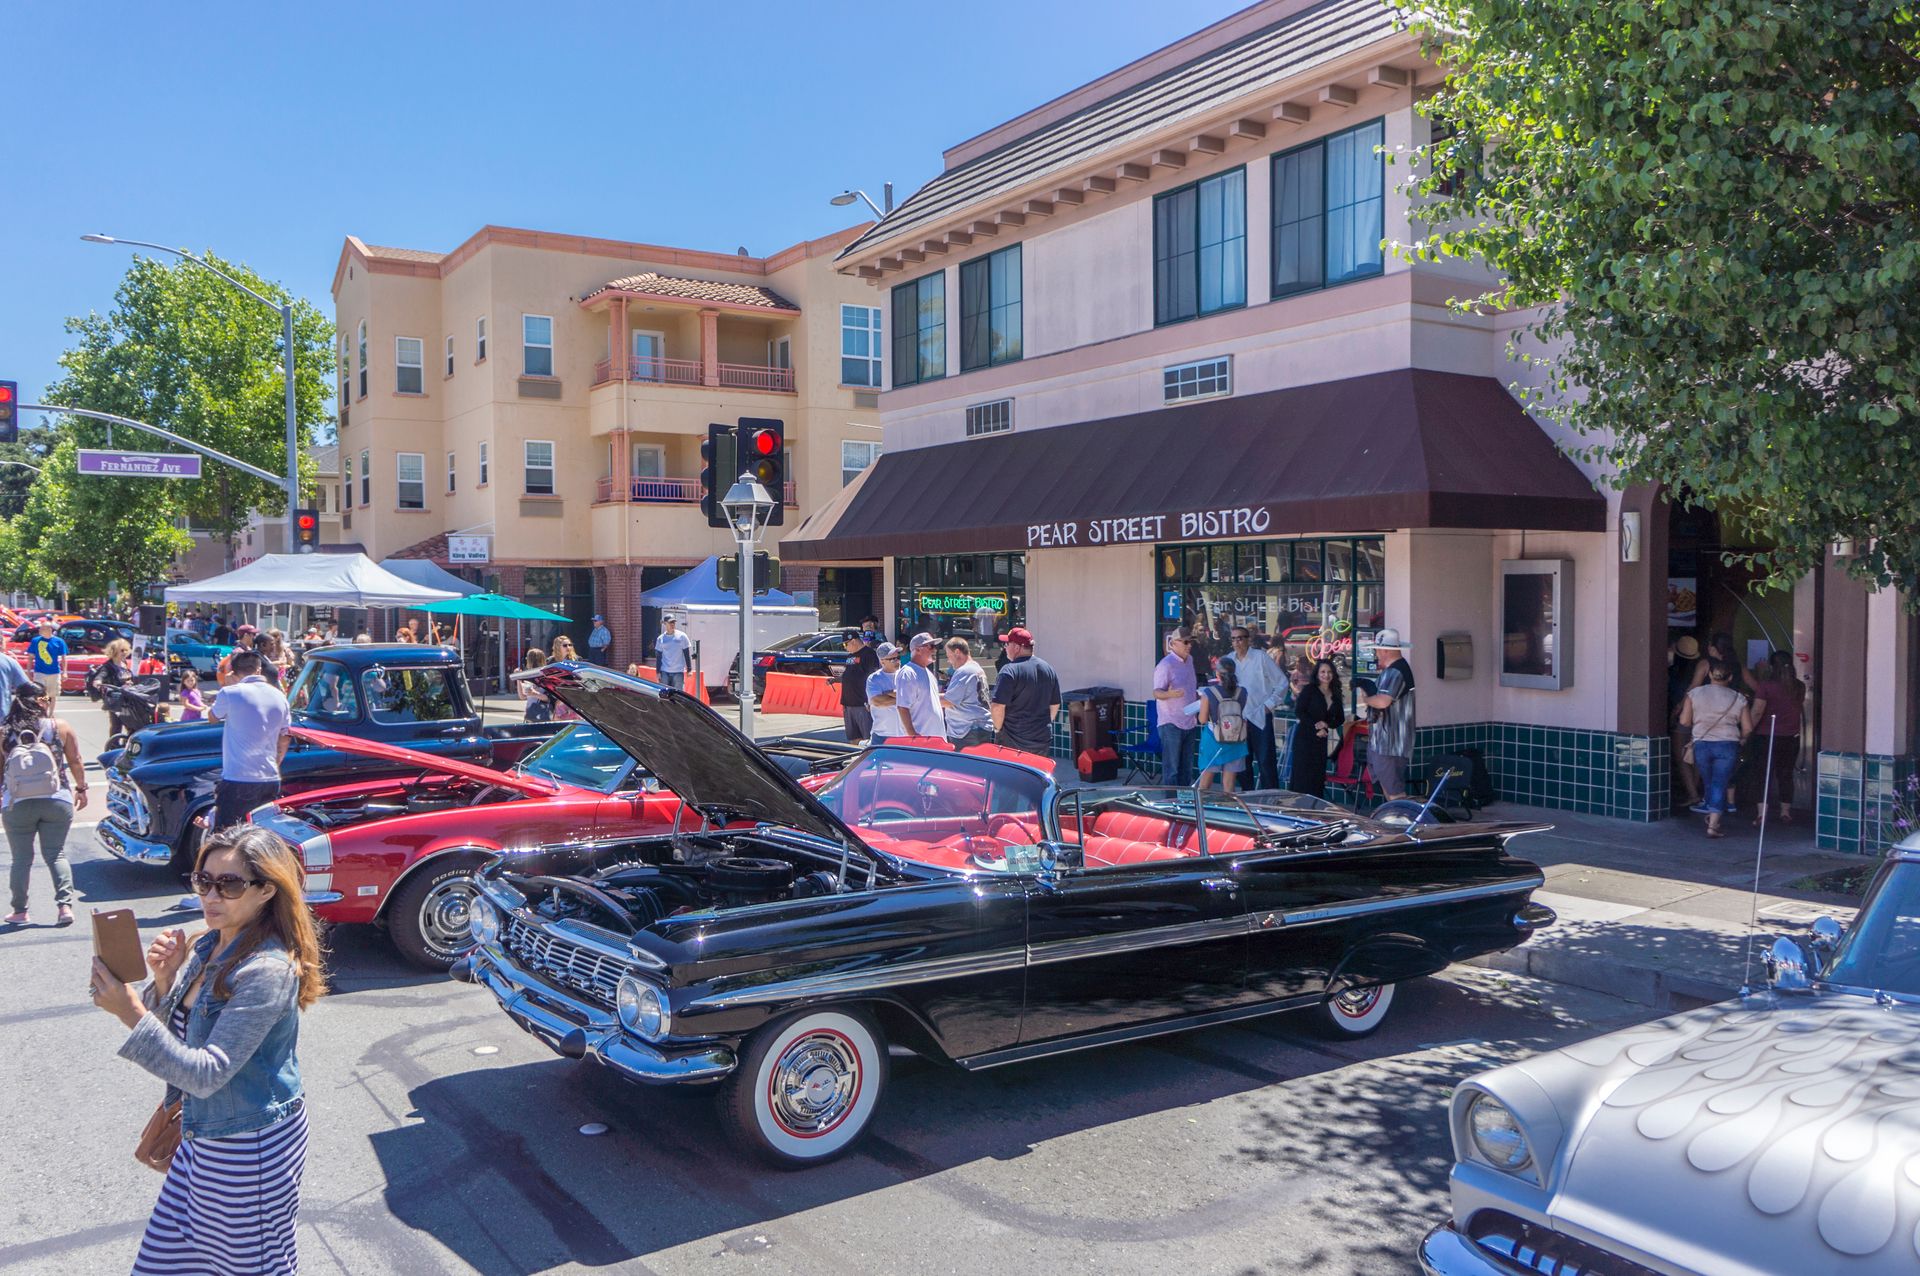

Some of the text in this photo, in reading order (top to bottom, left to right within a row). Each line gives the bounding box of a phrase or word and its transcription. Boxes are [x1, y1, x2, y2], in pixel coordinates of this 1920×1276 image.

[101, 461, 182, 473] FERNANDEZ AVE
[1027, 507, 1270, 547] PEAR STREET BISTRO
[922, 596, 1003, 610] PEAR STREET BISTRO
[1310, 637, 1352, 659] Open
[431, 869, 471, 885] Radial
[423, 946, 462, 963] odrich
